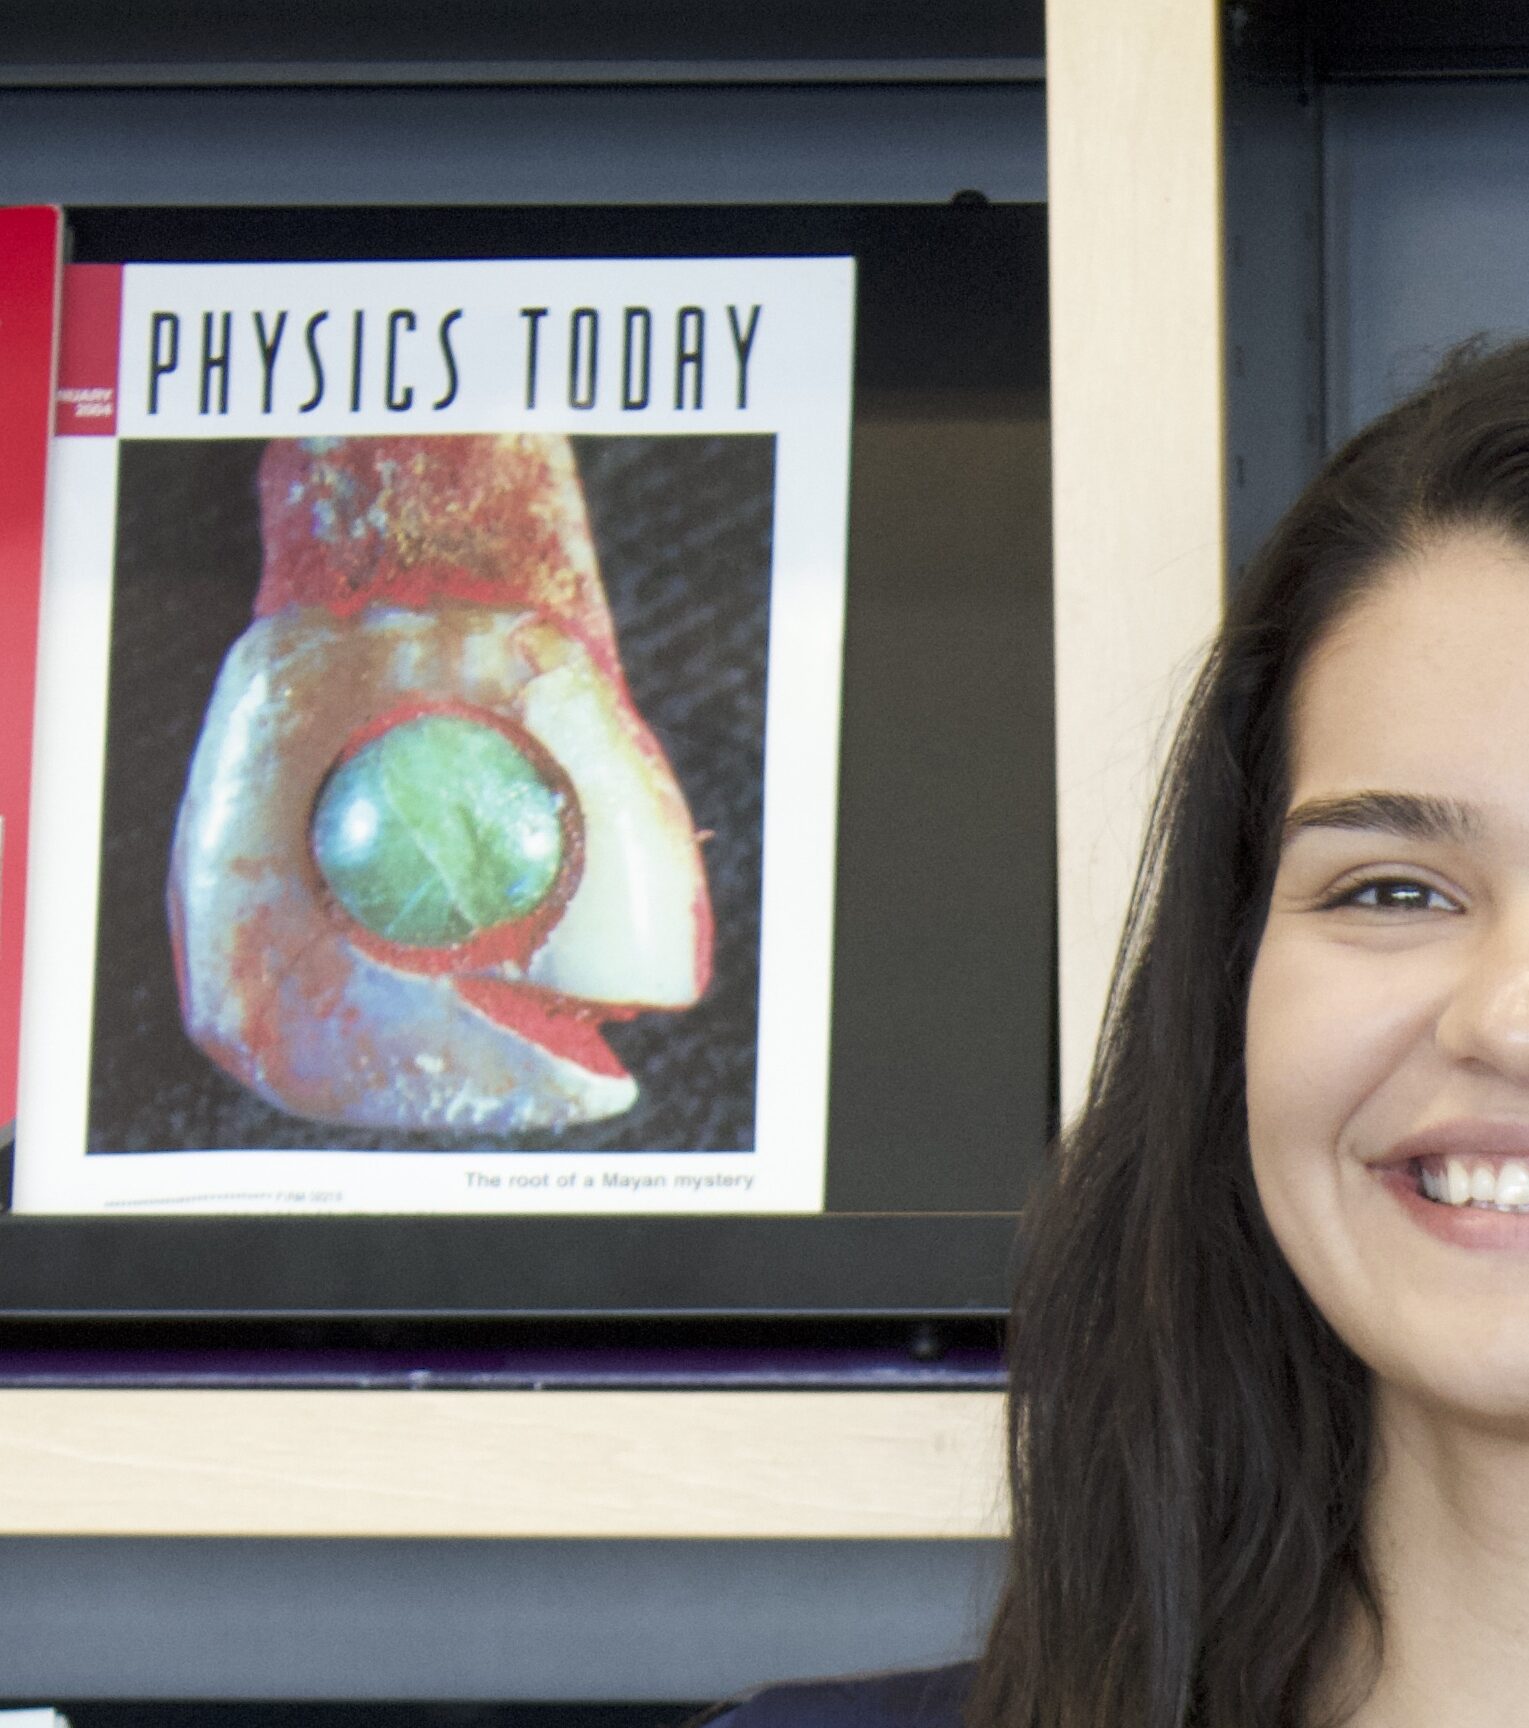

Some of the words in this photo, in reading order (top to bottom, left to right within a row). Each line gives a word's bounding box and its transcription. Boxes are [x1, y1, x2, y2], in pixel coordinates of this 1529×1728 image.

[147, 308, 464, 415] PHYSICS
[519, 304, 763, 411] TODAY
[465, 1171, 501, 1189] The
[508, 1171, 548, 1189] root
[556, 1171, 576, 1189] of
[583, 1175, 595, 1189] a
[601, 1171, 666, 1192] Mayan
[674, 1171, 755, 1192] mystery
